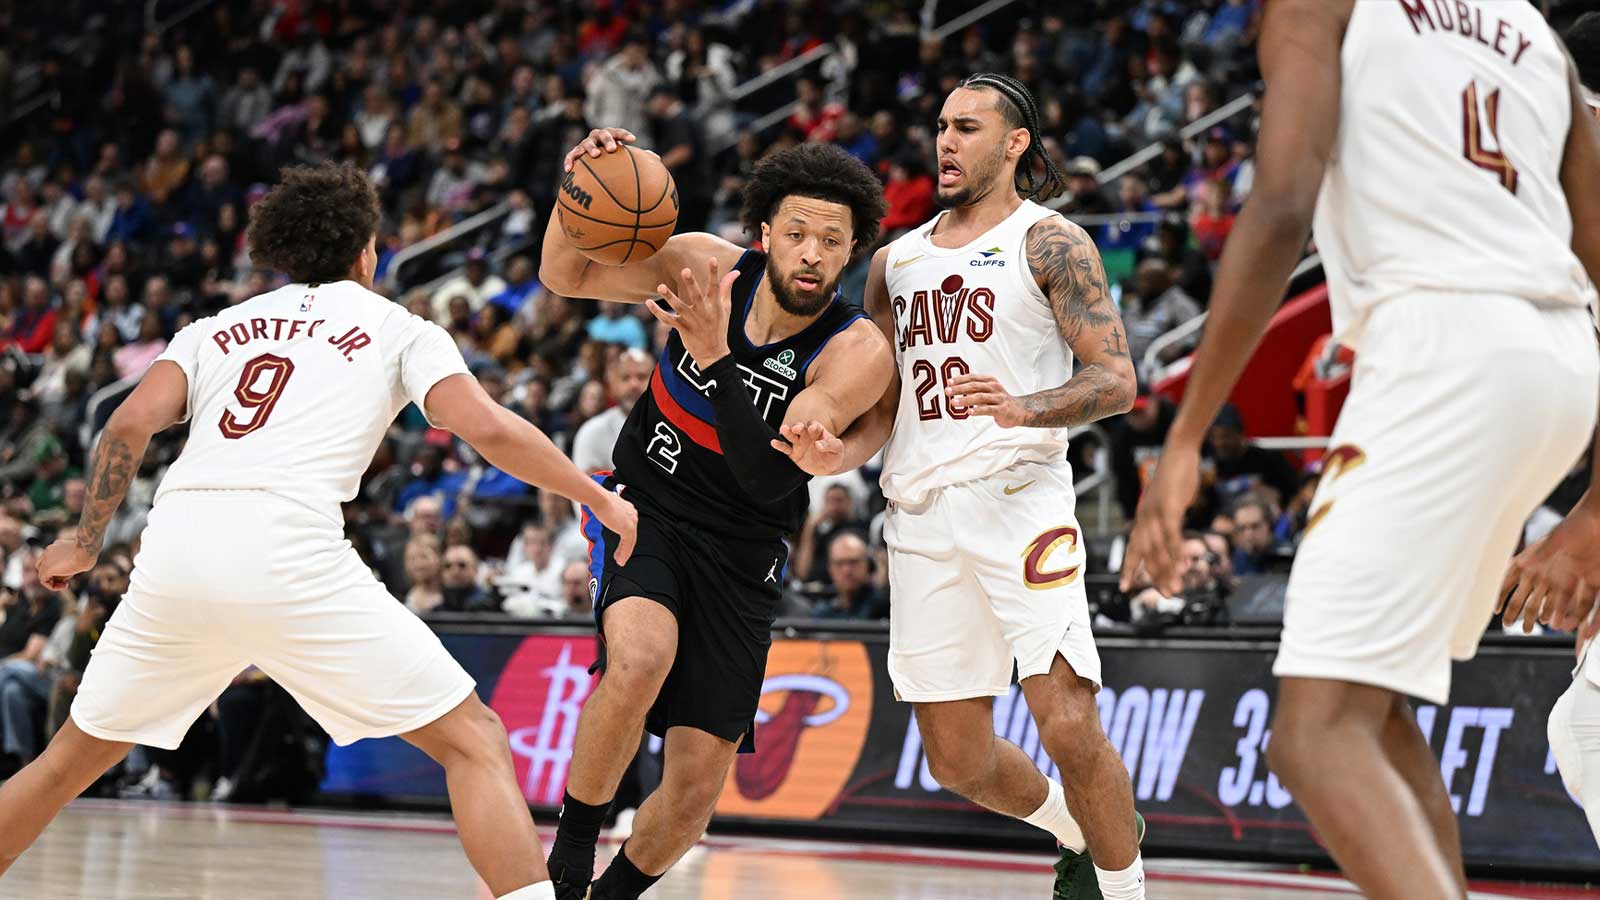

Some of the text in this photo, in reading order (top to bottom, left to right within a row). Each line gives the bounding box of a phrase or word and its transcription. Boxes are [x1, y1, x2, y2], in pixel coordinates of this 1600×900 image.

[1399, 0, 1532, 66] MOBLEY
[1461, 79, 1518, 196] 4
[969, 259, 1006, 267] CLIFFS
[327, 325, 372, 362] JR.
[893, 287, 996, 352] CAVS
[217, 352, 295, 439] 9
[646, 421, 682, 475] 2
